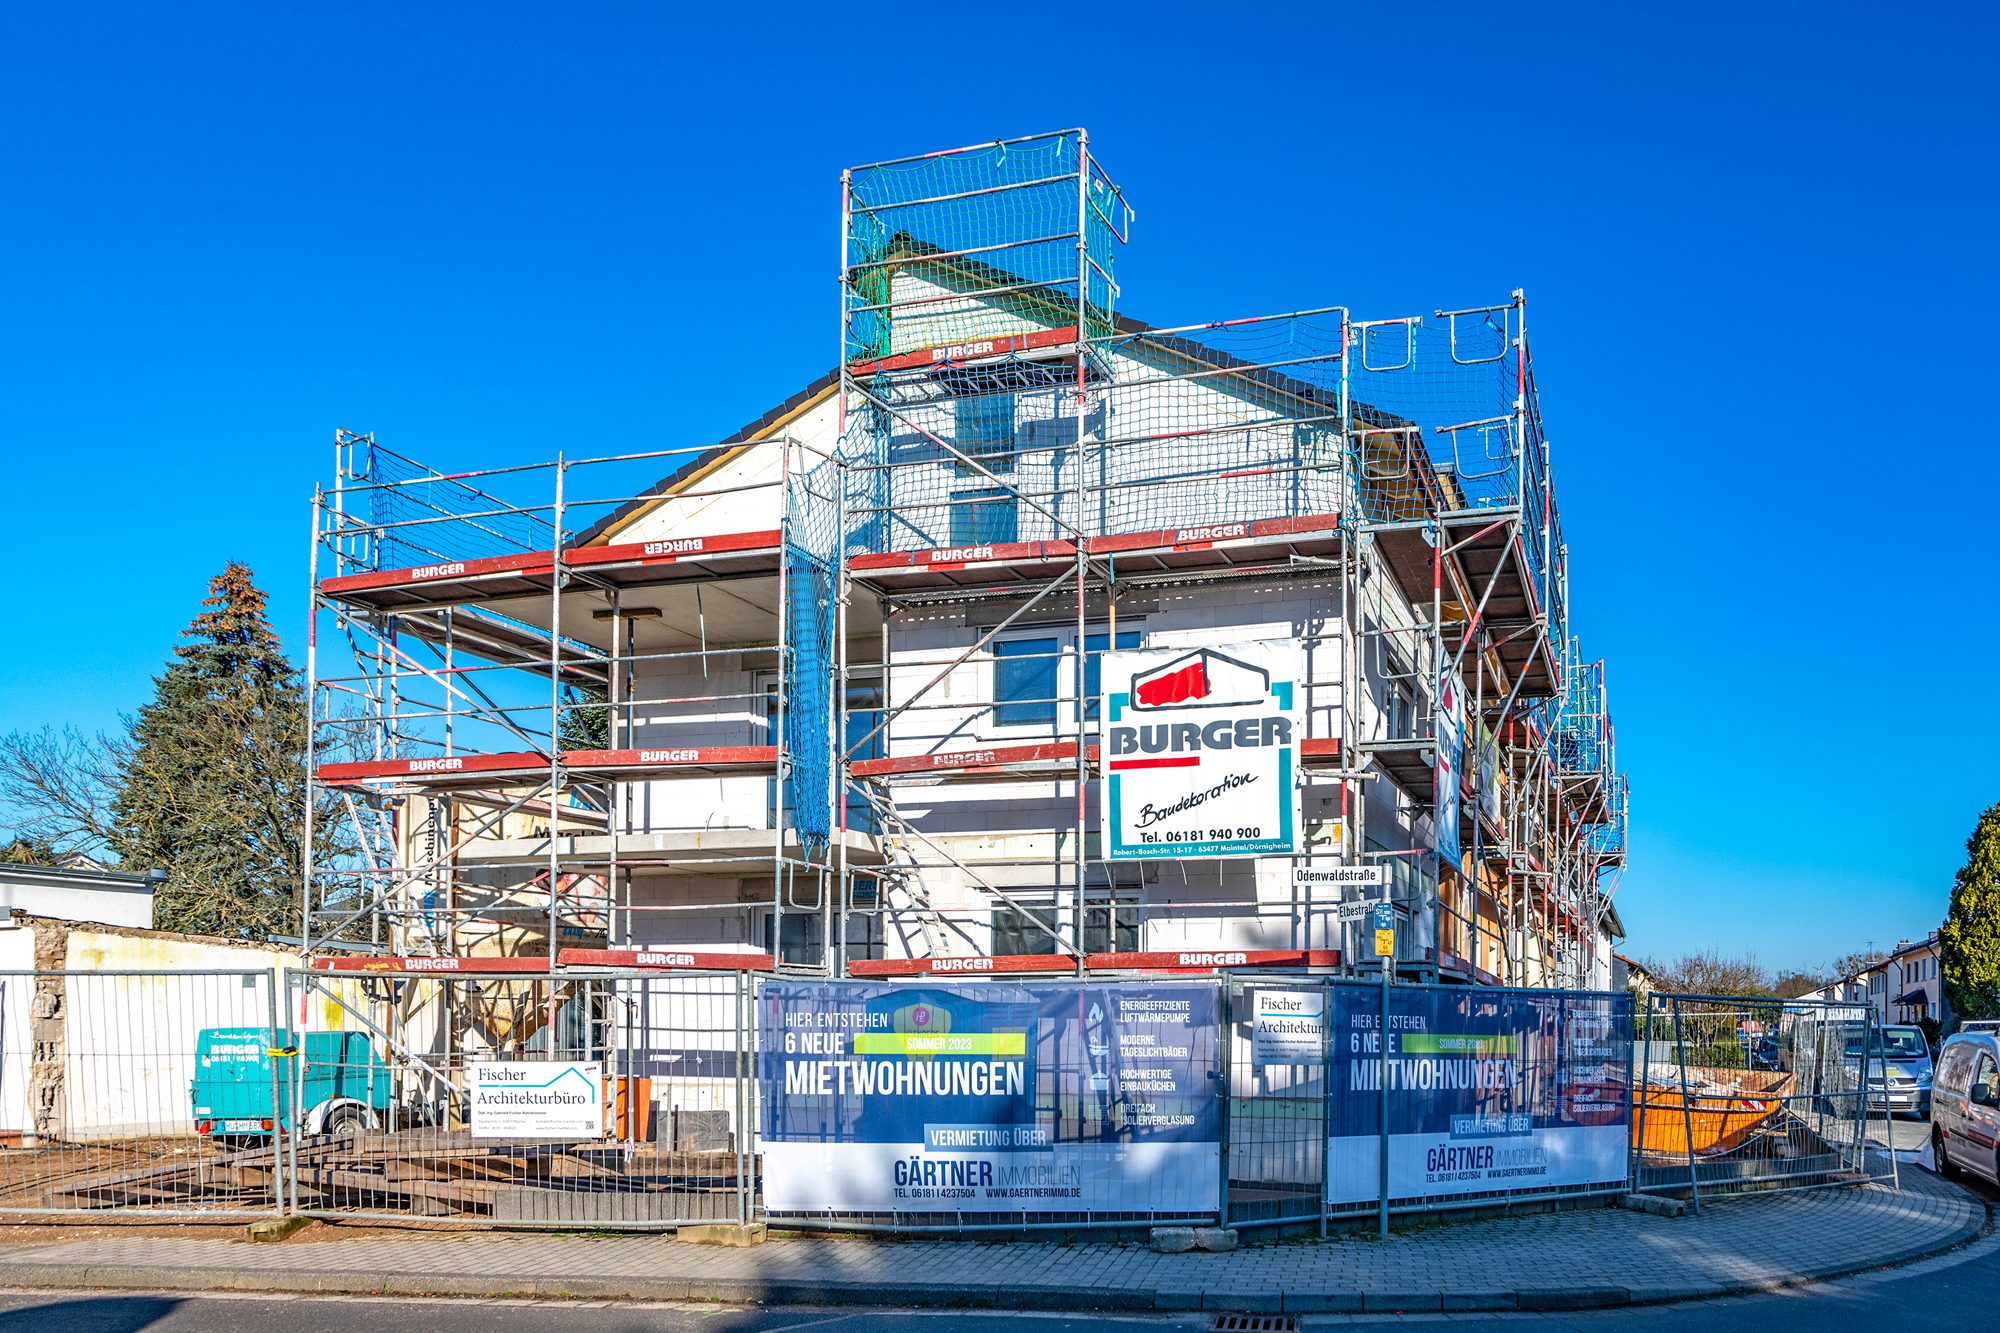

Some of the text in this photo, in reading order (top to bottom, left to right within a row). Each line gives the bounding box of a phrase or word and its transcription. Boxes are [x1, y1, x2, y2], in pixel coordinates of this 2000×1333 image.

[932, 341, 994, 361] BURGER
[1177, 524, 1246, 541] BURGER
[644, 538, 703, 555] BURGER
[931, 546, 993, 562] BURGER
[411, 563, 465, 579] BURGER
[1109, 716, 1293, 755] BURGER
[640, 749, 699, 763] BURGER
[409, 758, 463, 772] BURGER
[1134, 772, 1259, 828] Baudekoration
[1140, 827, 1261, 843] Tel. 06181 940 900
[1113, 842, 1291, 856] Robert-Bosch-Str. 15-17 63477 Maintal/Dörnigheim
[1296, 869, 1376, 881] Odenwaldstraße
[1339, 902, 1373, 917] Elbestraß
[405, 958, 459, 970] BURGER
[636, 953, 695, 966] BURGER
[931, 958, 994, 971] BURGER
[1179, 952, 1248, 966] BURGER
[1120, 1001, 1190, 1011] ENERGIEEFFIZIENTE
[1260, 996, 1302, 1011] Fischer
[785, 1013, 888, 1027] HIER ENTSTEHEN
[1120, 1011, 1190, 1023] LUFTWÄRMEPUMPE
[1351, 1014, 1426, 1030] HIER ETSTEHEN
[785, 1032, 845, 1054] 6 NEUE
[906, 1037, 972, 1050] SOMMER 2023
[1120, 1035, 1155, 1045] MODERNE
[1351, 1032, 1396, 1053] 6 NEE
[1439, 1038, 1466, 1049] SOMMER
[210, 1044, 259, 1055] BURGER
[1120, 1046, 1188, 1057] TAGESLICHTBÄDER
[478, 1067, 527, 1081] Fischer
[785, 1061, 1024, 1096] MIETWOHNUNGEN
[1120, 1069, 1172, 1079] HOCHWERTIGE
[1120, 1080, 1176, 1091] EINBAUKÜCHEN
[477, 1091, 586, 1105] Architekturbüro
[1120, 1104, 1156, 1113] DREIFACH
[1120, 1115, 1195, 1126] ISOLIERVERGLASUNG
[1454, 1115, 1529, 1134] VERMIETUNG ÜBER
[930, 1127, 1047, 1146] VERMIETUNG ÜBER
[1426, 1144, 1494, 1172] GÄRTNER
[894, 1156, 1080, 1187] GÄRTNER IMMOBILIEN
[1426, 1173, 1437, 1183] TEL.
[894, 1188, 910, 1198] TEL.
[911, 1188, 936, 1198] 06181
[941, 1188, 976, 1198] 4237504
[985, 1188, 1081, 1198] WWW.GAERTNERIMMO.DE
